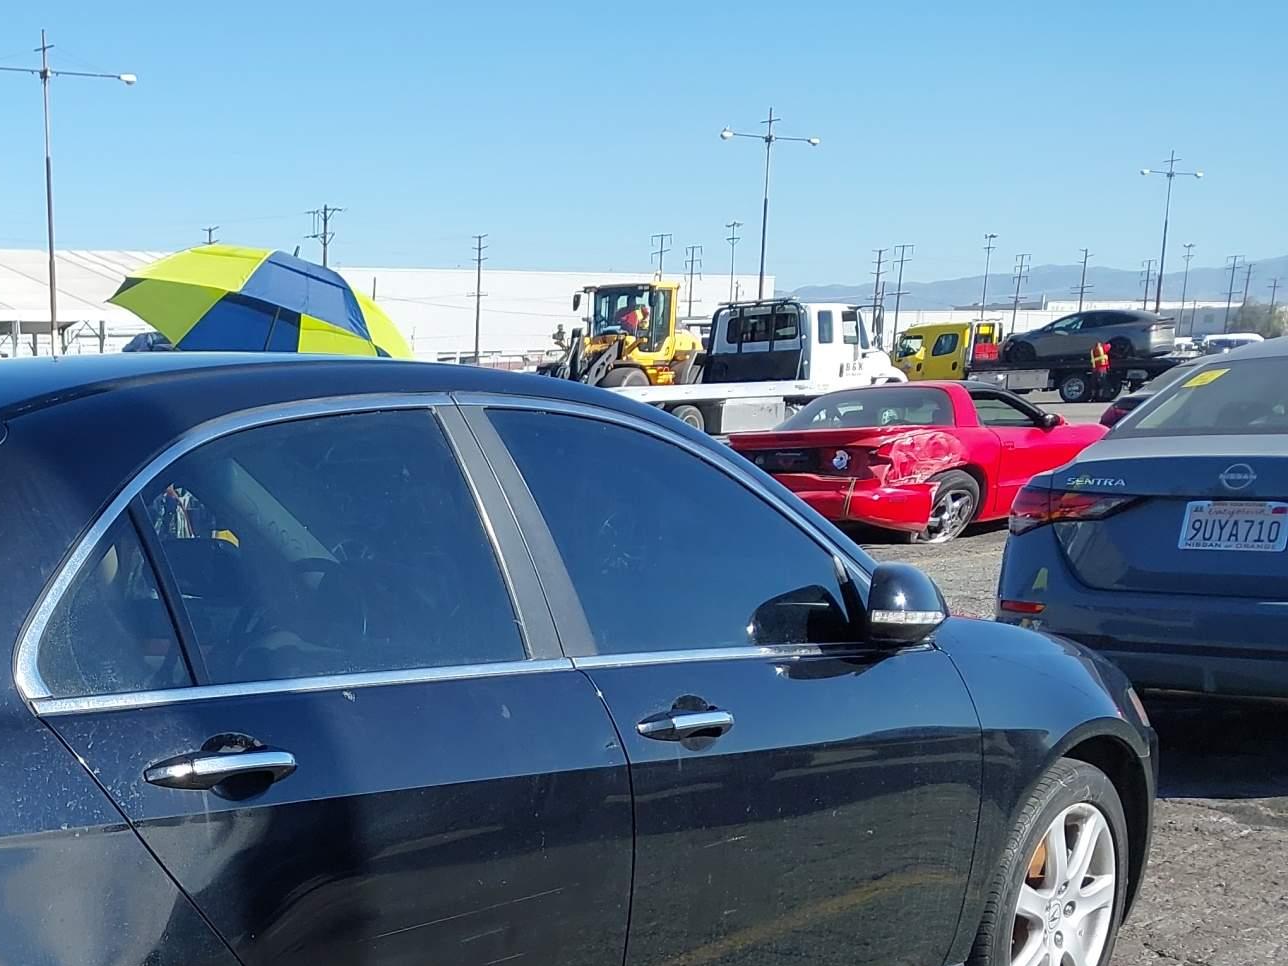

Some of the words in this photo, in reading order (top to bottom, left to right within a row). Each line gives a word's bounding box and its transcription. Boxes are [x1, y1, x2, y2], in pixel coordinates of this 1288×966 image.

[1066, 477, 1126, 487] SENTRA
[1218, 473, 1257, 481] NISSAN
[1188, 519, 1281, 543] 9UYA710
